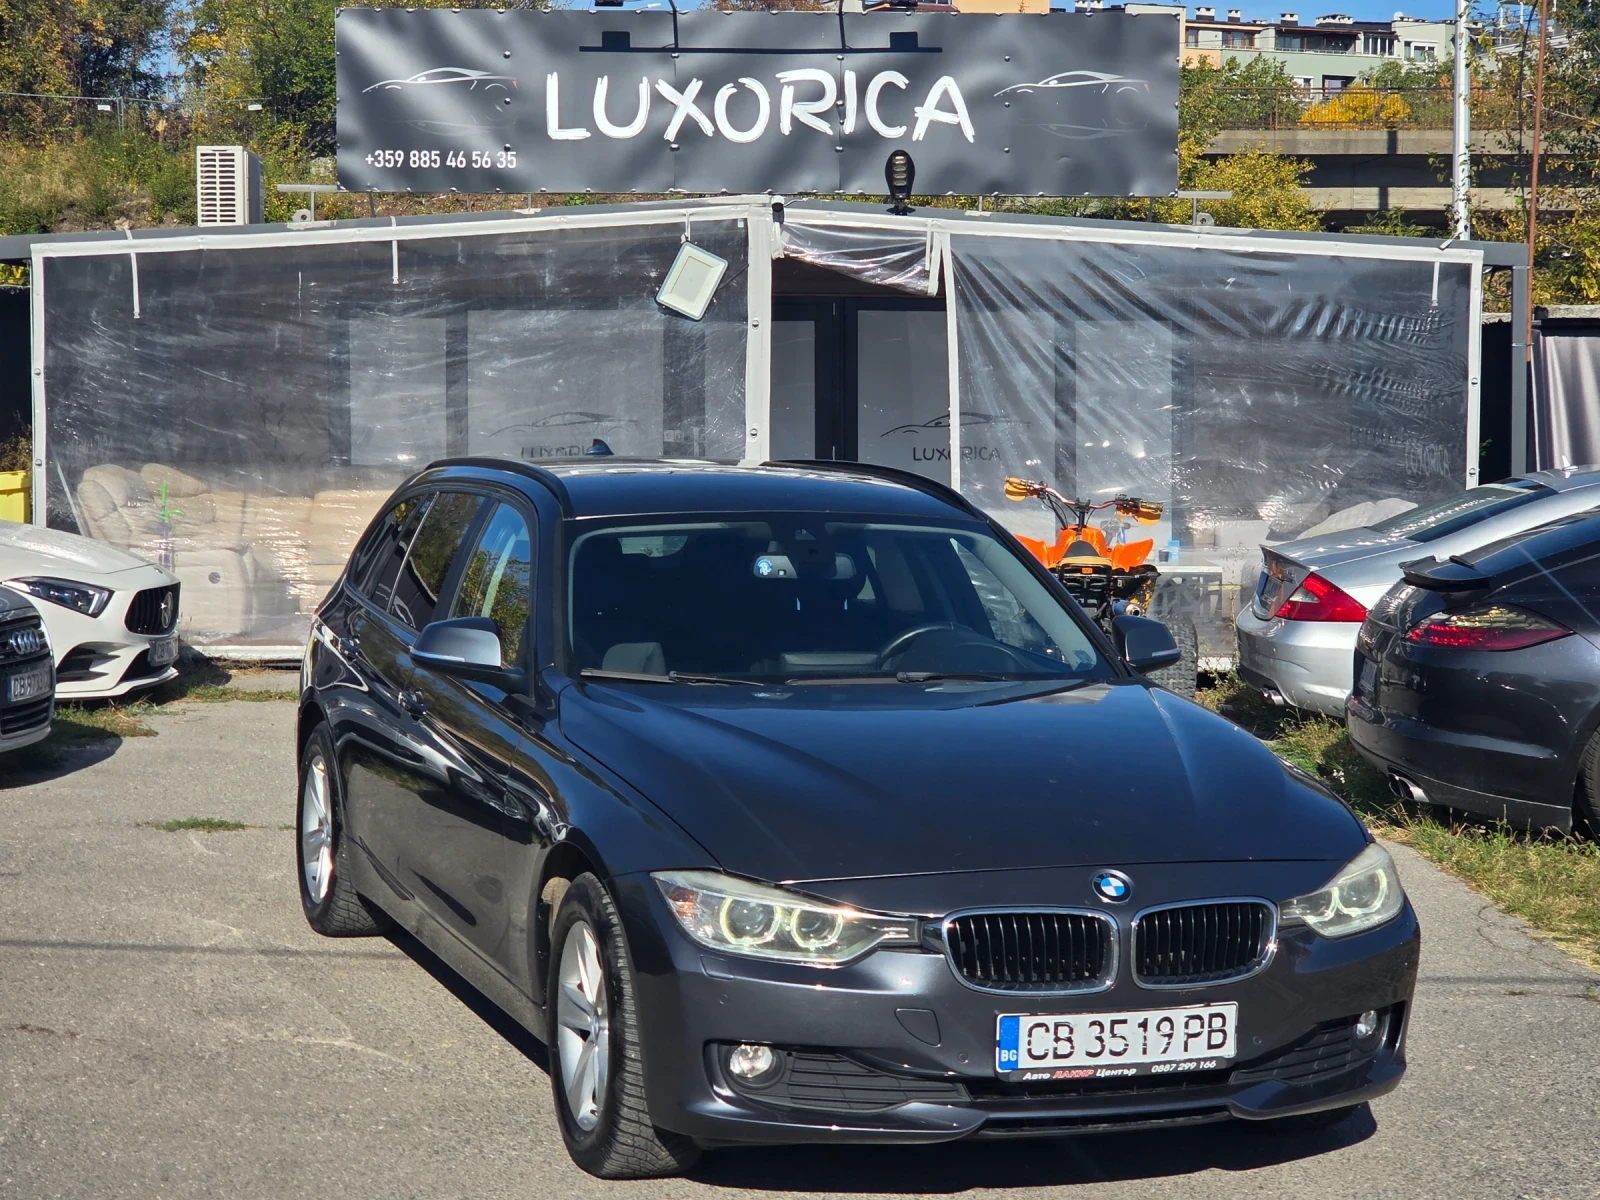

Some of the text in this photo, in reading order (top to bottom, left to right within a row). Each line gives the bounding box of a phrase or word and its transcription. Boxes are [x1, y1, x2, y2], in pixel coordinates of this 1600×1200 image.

[546, 68, 975, 143] LUXORICA
[365, 150, 517, 169] +359 885 46 56 35
[913, 447, 1001, 461] LUXRICA
[1027, 1012, 1228, 1060] CB 3519 PB
[1000, 1049, 1017, 1062] BG
[1023, 1072, 1050, 1080] Авто
[1096, 1068, 1137, 1077] Център
[1151, 1063, 1177, 1073] 0887
[1177, 1061, 1197, 1071] 299
[1199, 1060, 1217, 1069] 166
